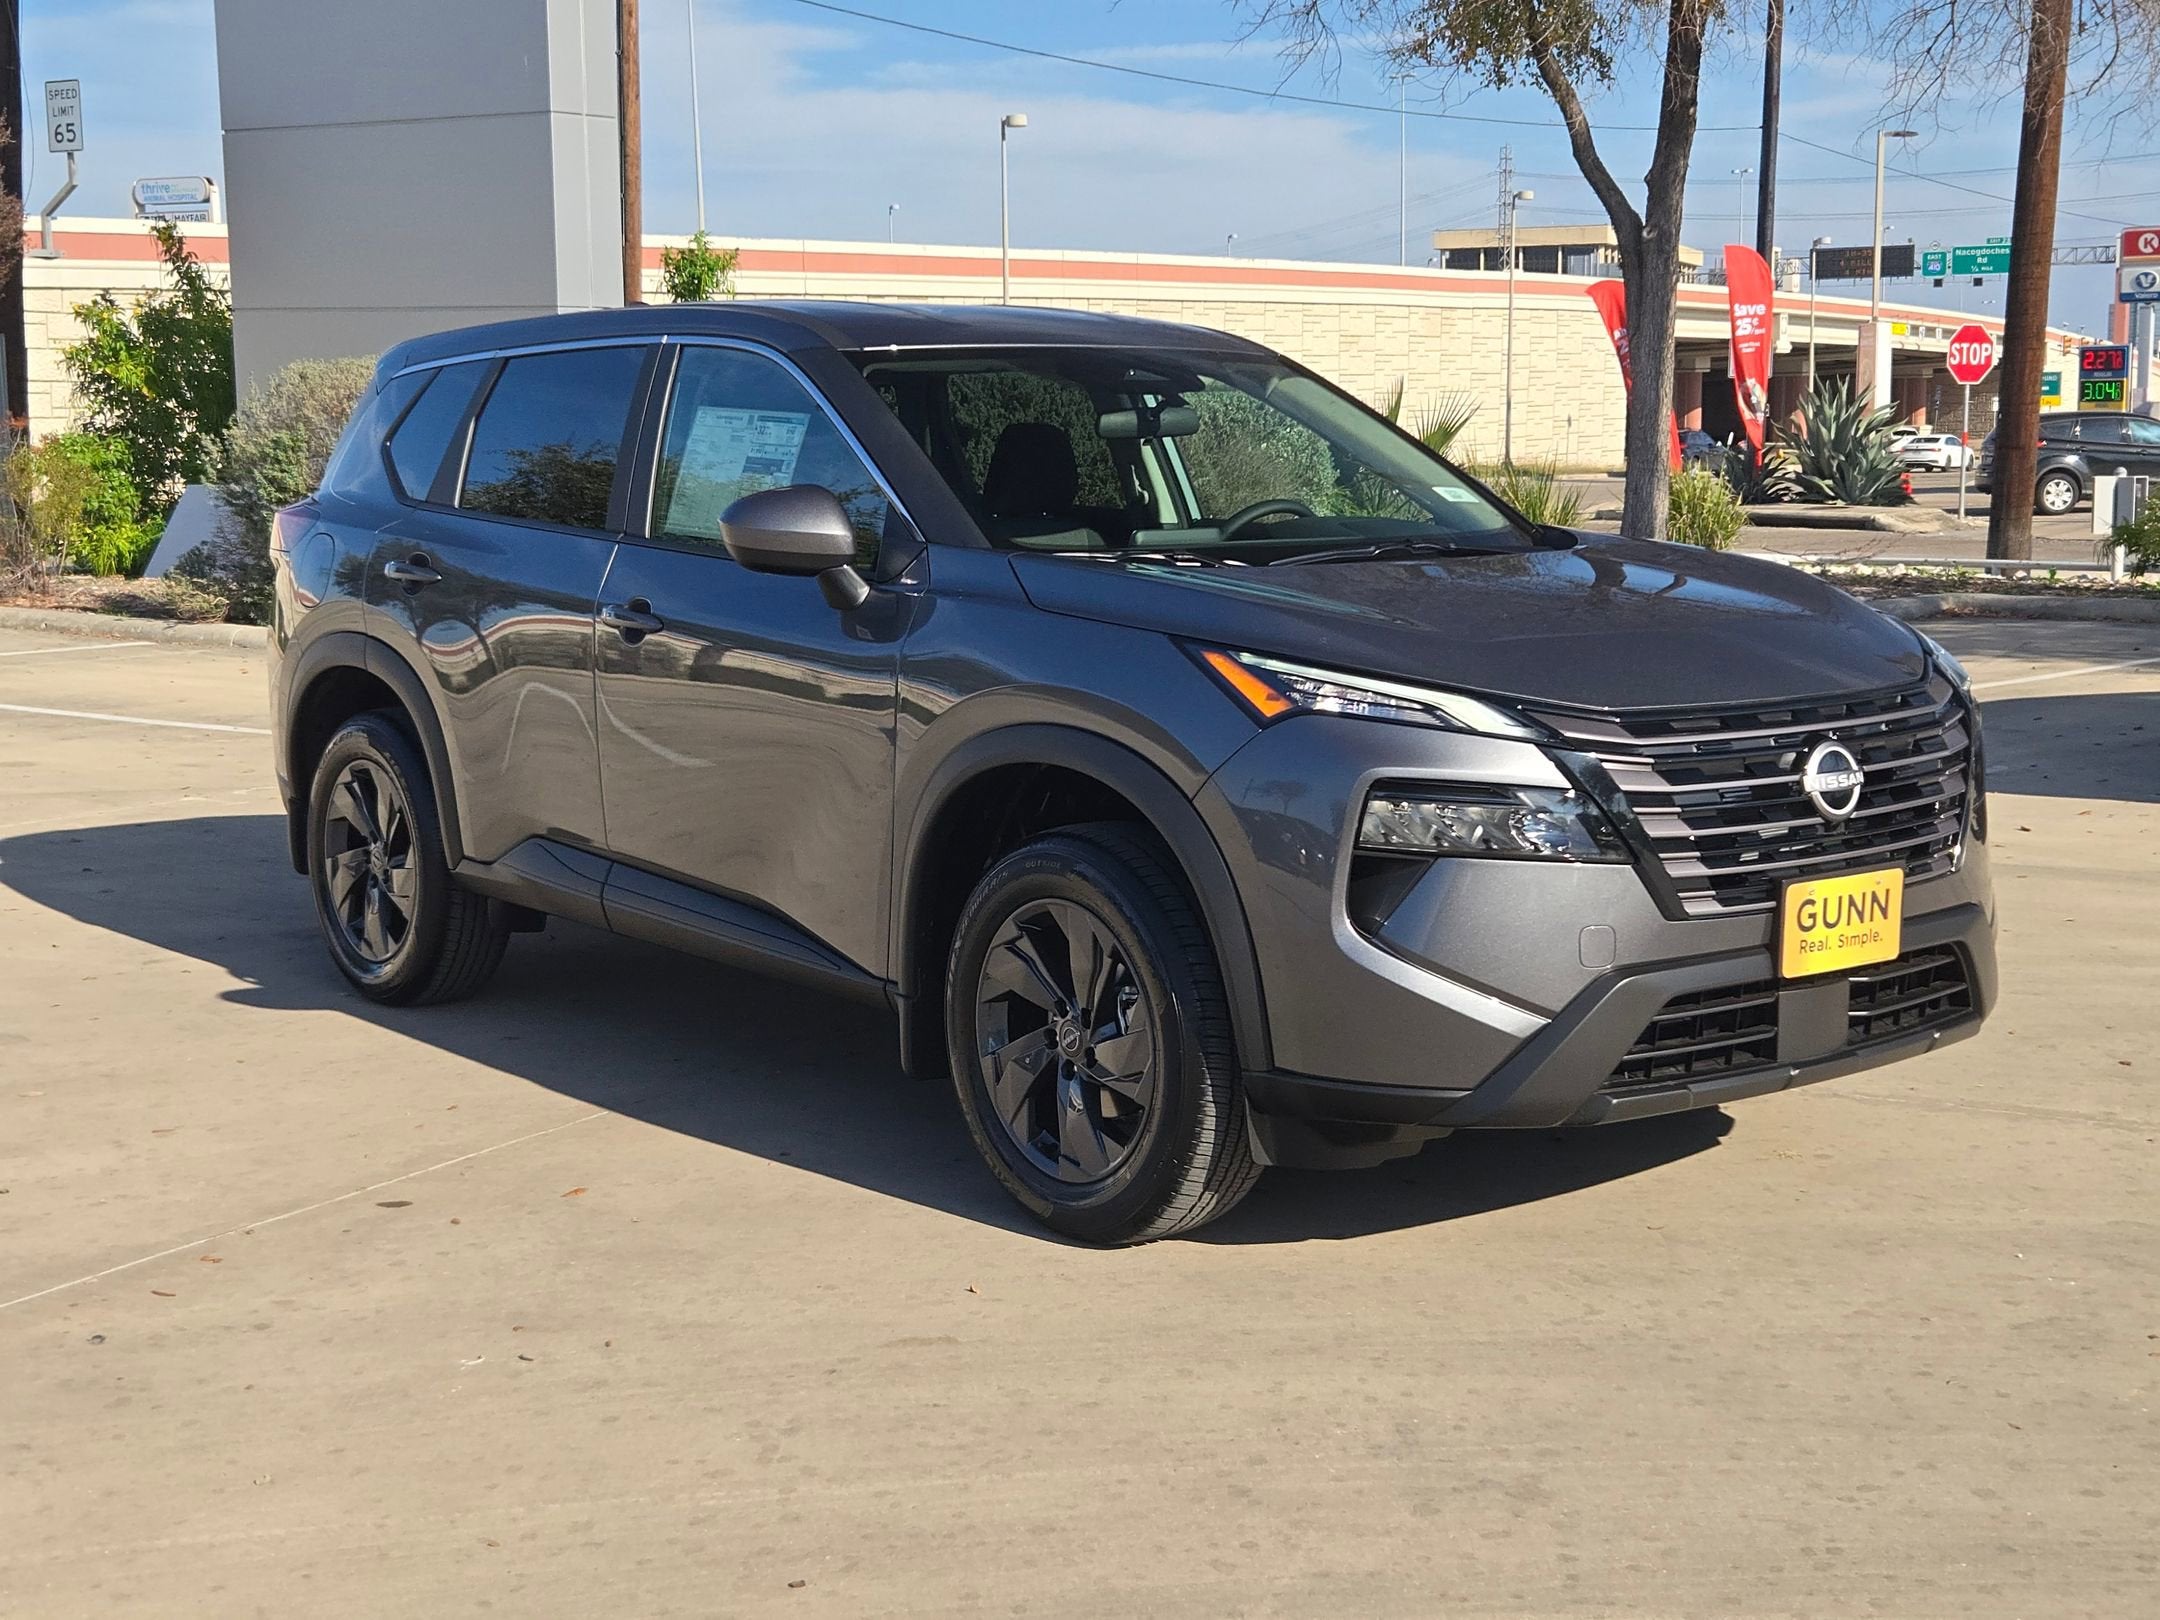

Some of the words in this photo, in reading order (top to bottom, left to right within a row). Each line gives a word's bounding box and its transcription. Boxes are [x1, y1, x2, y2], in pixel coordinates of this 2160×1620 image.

[48, 88, 78, 101] SPEED
[52, 105, 75, 118] LIMIT
[54, 123, 77, 143] 65
[141, 182, 171, 195] thrive
[167, 193, 199, 203] HOSPITAL
[1955, 246, 2010, 257] Nacogdoches
[1976, 256, 1988, 264] Rd
[1927, 263, 1941, 271] 410
[2134, 292, 2159, 300] Valero
[1733, 303, 1766, 317] Save
[1949, 342, 1992, 366] STOP
[1807, 769, 1865, 791] NISSAN
[1796, 887, 1890, 934] GUNN
[1799, 932, 1832, 955] Real.
[1837, 928, 1884, 950] Simple.
